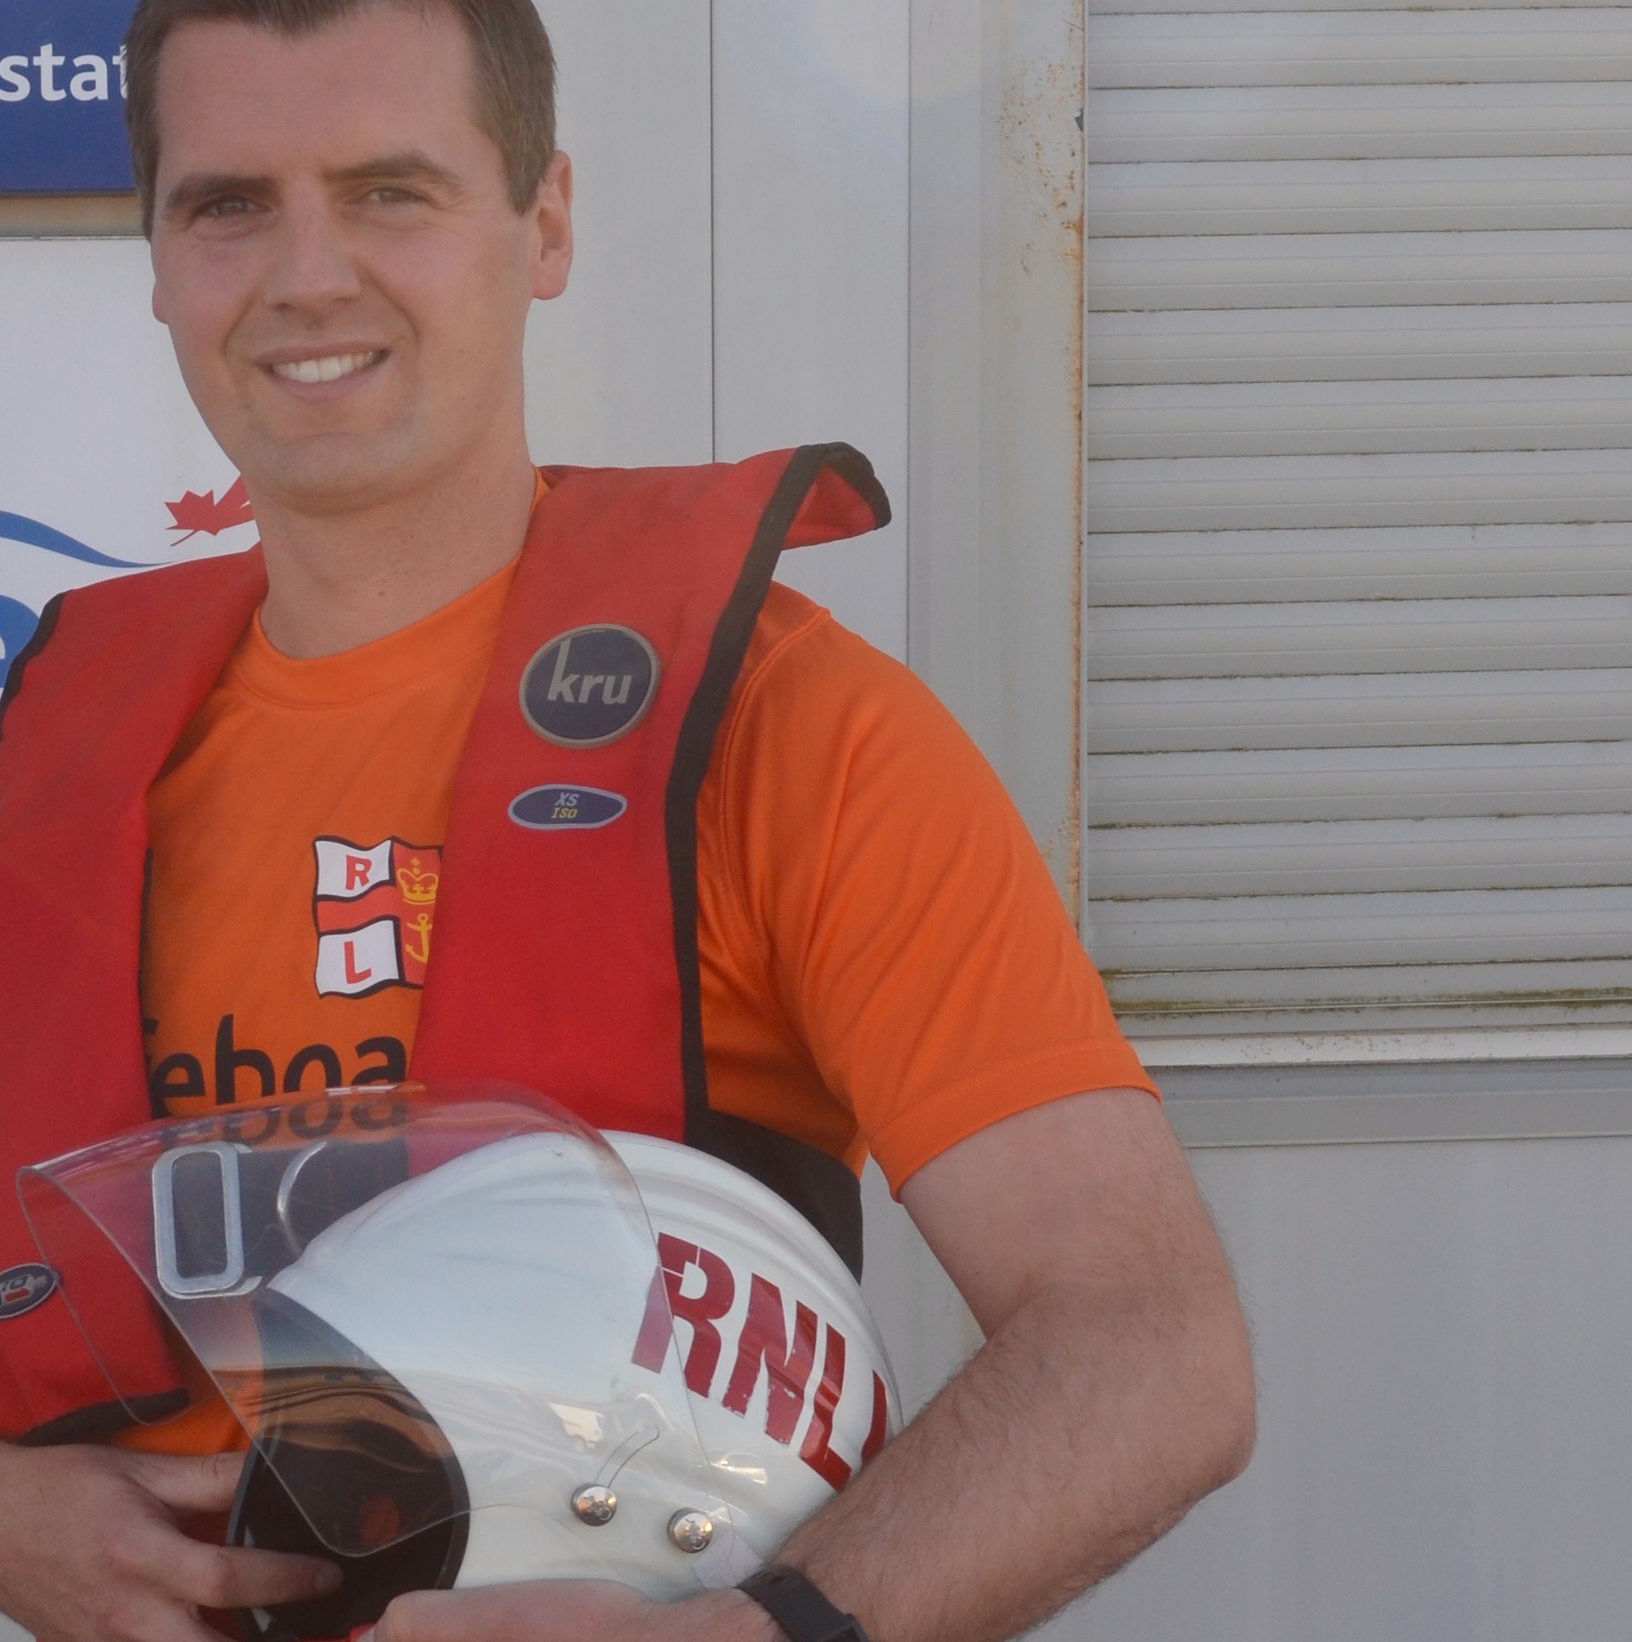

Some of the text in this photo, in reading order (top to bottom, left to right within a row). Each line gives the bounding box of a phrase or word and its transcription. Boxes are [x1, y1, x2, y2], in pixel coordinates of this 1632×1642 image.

[547, 636, 632, 705] kru
[345, 854, 372, 891] R
[344, 941, 372, 985] L
